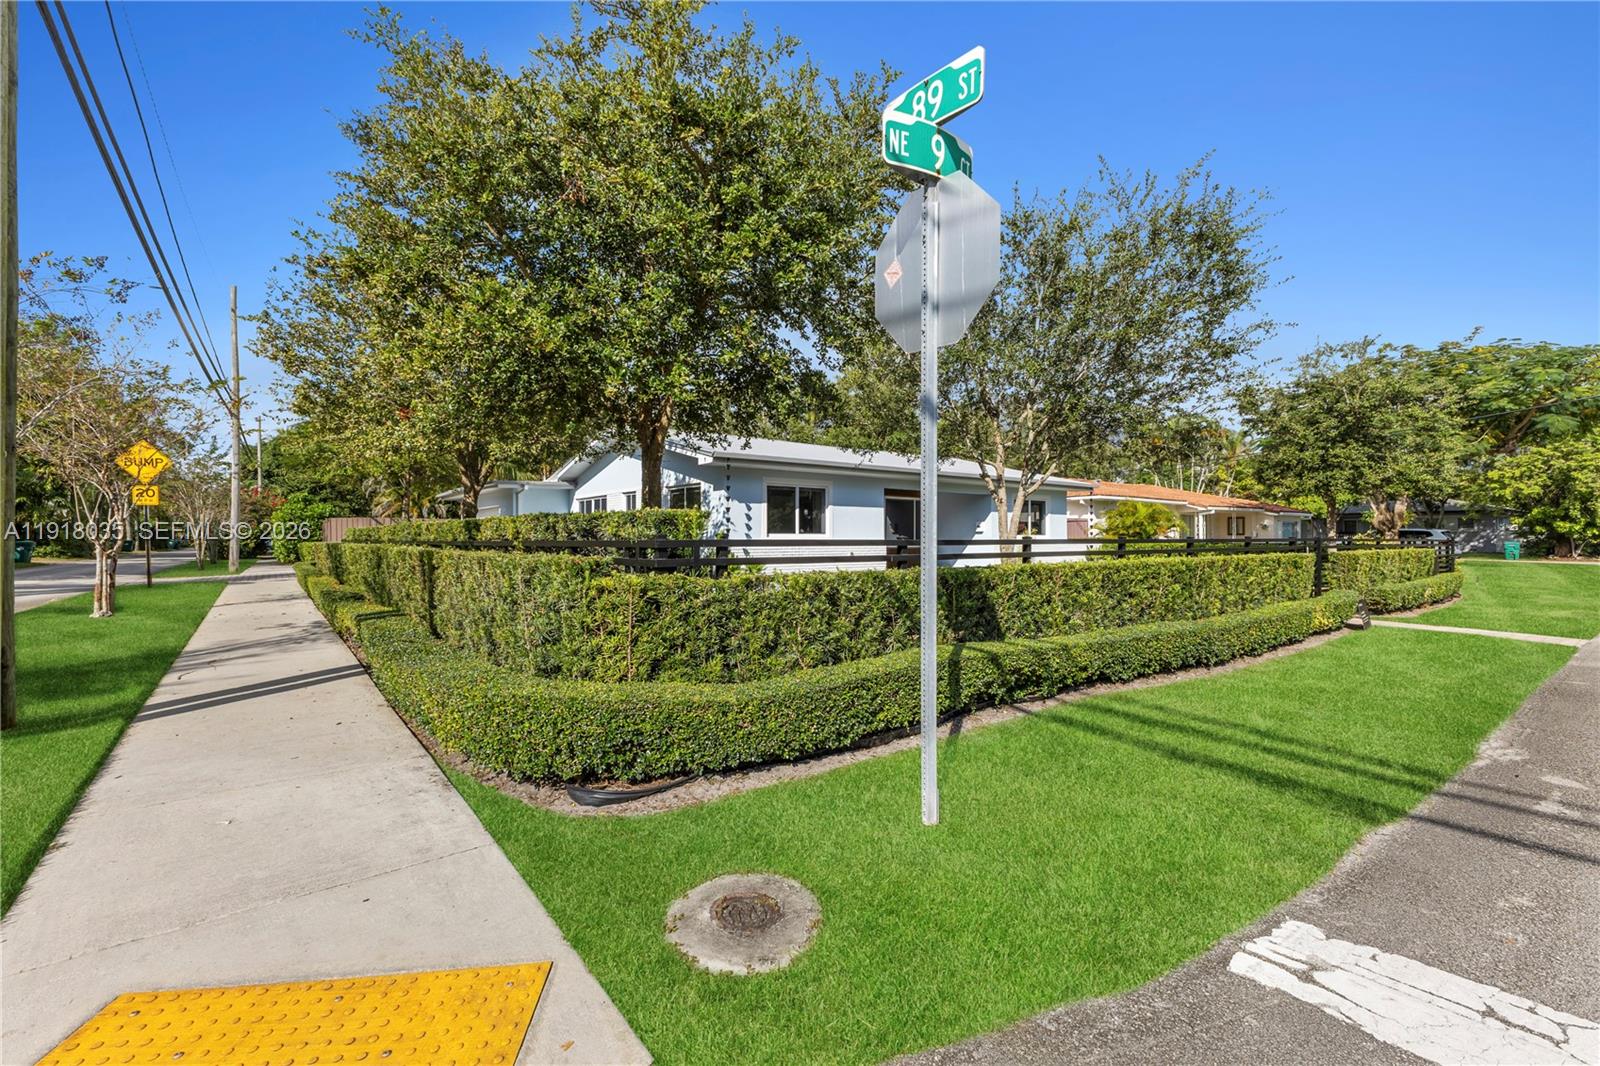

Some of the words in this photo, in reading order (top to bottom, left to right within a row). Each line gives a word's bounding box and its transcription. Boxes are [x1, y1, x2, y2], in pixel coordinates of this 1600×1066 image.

[912, 79, 944, 120] 89
[958, 66, 978, 100] ST
[889, 127, 910, 157] NE
[931, 134, 945, 169] 9
[123, 457, 164, 468] BUMP
[135, 488, 156, 498] 20
